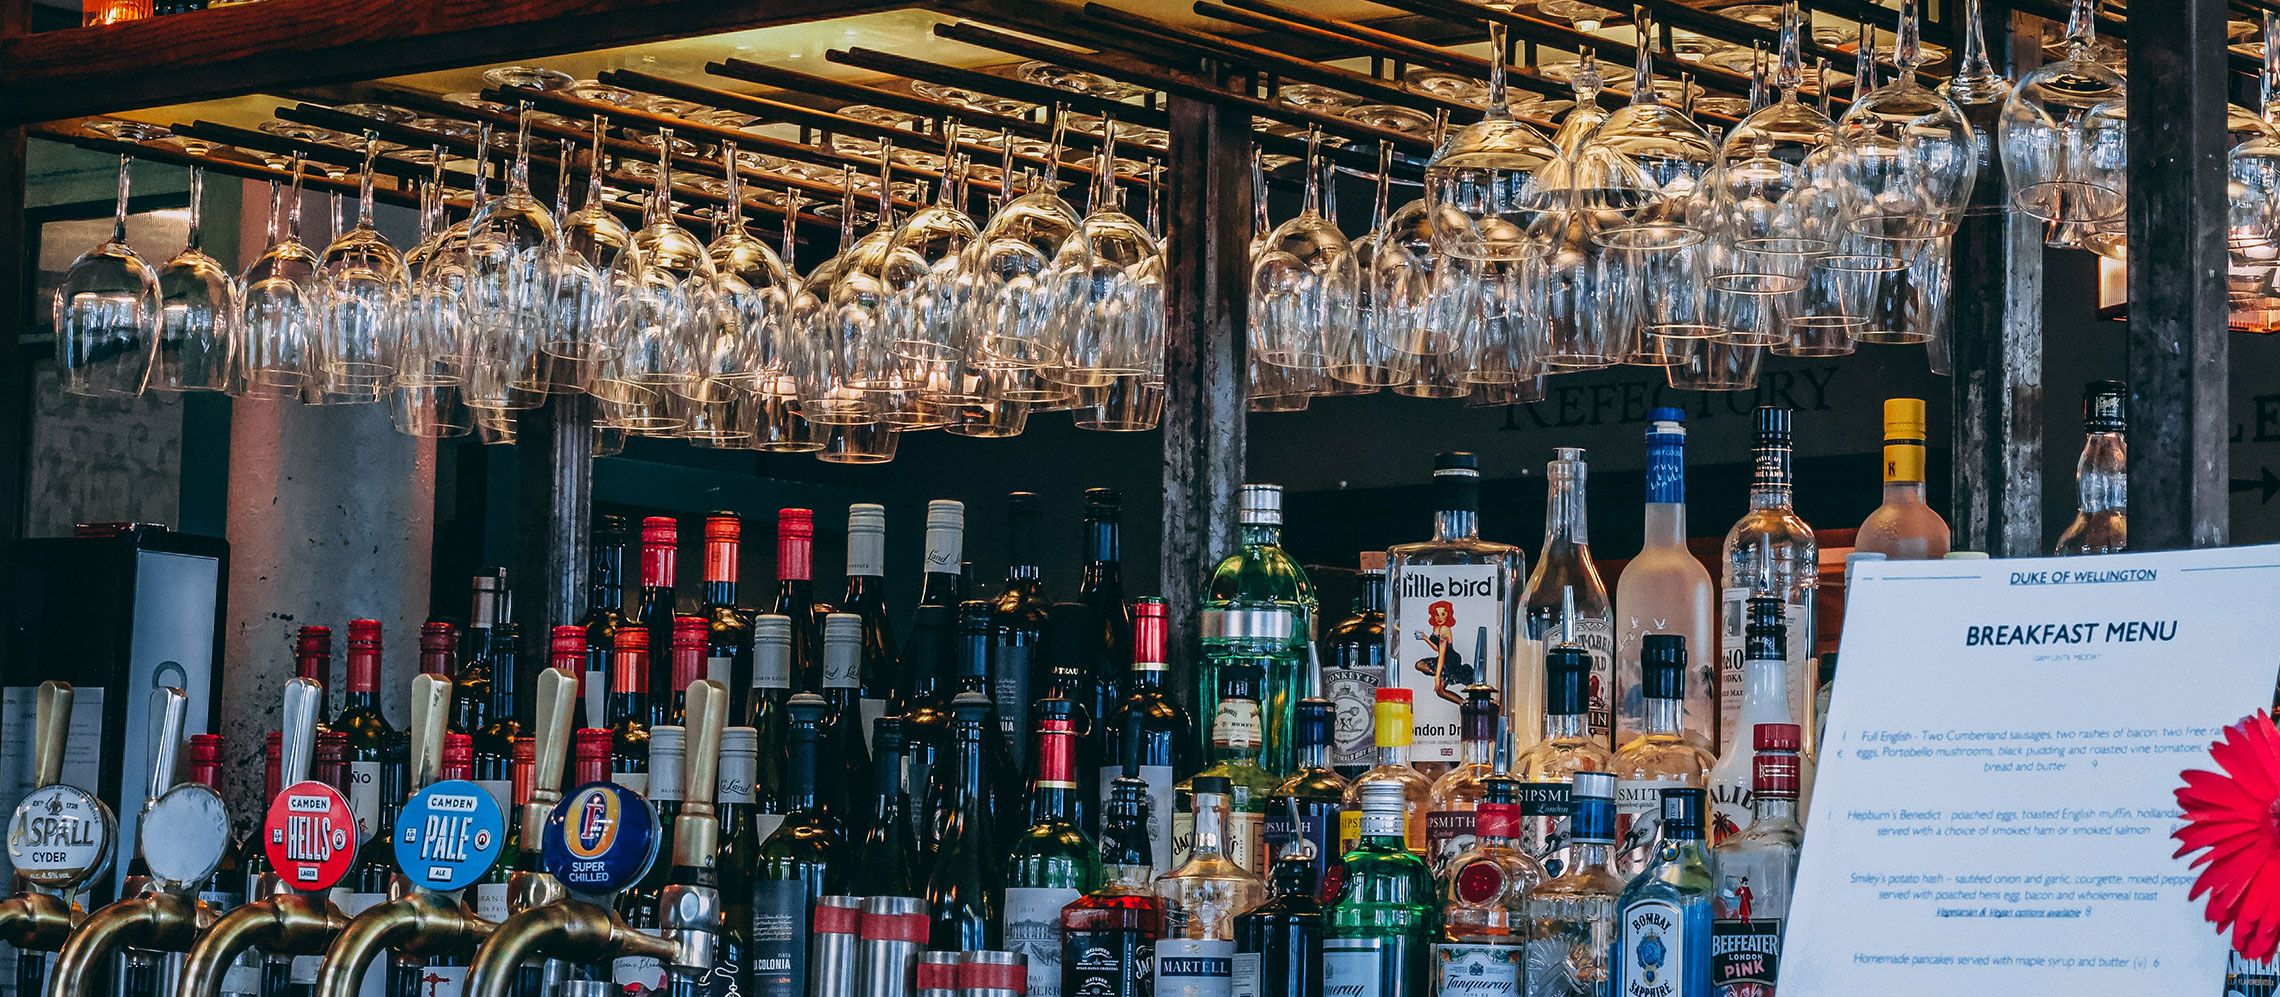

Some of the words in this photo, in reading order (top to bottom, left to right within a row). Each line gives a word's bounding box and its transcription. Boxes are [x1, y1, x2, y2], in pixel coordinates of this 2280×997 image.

[2010, 572, 2047, 584] DUKE
[2051, 571, 2071, 583] OF
[2074, 569, 2157, 582] WELLINGTON
[1449, 576, 1492, 597] bird
[1966, 623, 2099, 646] BREAKFAST
[2105, 620, 2177, 642] MENU
[1364, 676, 1377, 685] 47
[1592, 712, 1607, 725] IN
[1861, 731, 1878, 741] Full
[1881, 731, 1911, 744] English
[1922, 731, 1943, 741] Two
[1947, 730, 2007, 741] Cumberland
[2056, 731, 2076, 739] two
[2079, 730, 2109, 739] rashes
[2113, 728, 2124, 738] of
[2163, 728, 2182, 737] two
[2186, 727, 2206, 737] free
[1883, 747, 1933, 757] Portobello
[1999, 746, 2022, 756] black
[2025, 746, 2065, 757] pudding
[2068, 745, 2086, 754] and
[2090, 745, 2127, 754] roasted
[2130, 745, 2149, 754] vine
[1984, 762, 2012, 772] bread
[2016, 762, 2033, 771] and
[2036, 761, 2067, 771] butter
[2091, 759, 2098, 769] 9
[727, 780, 750, 795] Land
[1519, 790, 1569, 801] SIPSMI
[291, 799, 327, 809] CAMDEN
[431, 798, 473, 809] CAMDEN
[1847, 810, 1896, 823] Hepburn's
[1900, 809, 1942, 820] Benedict
[1951, 809, 1993, 822] poached
[2022, 810, 2058, 819] toasted
[2062, 808, 2096, 821] English
[2137, 808, 2179, 819] hollanda
[10, 811, 94, 853] ASPALL
[287, 815, 331, 861] HELLS
[421, 814, 473, 861] PALE
[1877, 826, 1910, 836] served
[1913, 825, 1933, 835] with
[1936, 828, 1941, 836] a
[1944, 825, 1976, 836] choice
[1979, 825, 1990, 835] of
[1992, 826, 2030, 836] smoked
[2034, 825, 2055, 835] ham
[2058, 827, 2069, 835] or
[2073, 825, 2112, 835] smoked
[2115, 826, 2151, 835] salmon
[1174, 831, 1192, 855] JAC
[32, 852, 67, 863] CYDER
[572, 862, 605, 872] SUPER
[569, 873, 609, 882] CHILLED
[1850, 873, 1886, 887] Smiley's
[1888, 874, 1920, 885] potato
[1922, 873, 1944, 884] hash
[1994, 875, 2022, 884] onion
[2024, 874, 2042, 884] and
[2127, 874, 2159, 884] mixed
[1879, 890, 1910, 900] served
[1912, 889, 1932, 899] with
[1935, 889, 1976, 901] poached
[1979, 890, 2000, 899] hens
[2025, 891, 2053, 900] bacon
[2057, 891, 2075, 900] and
[2078, 891, 2132, 900] wholemeal
[2134, 891, 2158, 900] toast
[1632, 913, 1672, 935] BOMBAY
[1712, 934, 1778, 957] BEEFEATER
[759, 959, 791, 970] COLONIA
[1135, 956, 1154, 979] JAC
[1163, 961, 1228, 973] MARTELL
[1853, 953, 1909, 965] Homemade
[1912, 954, 1954, 966] pancakes
[1957, 954, 1989, 966] served
[1992, 955, 2014, 966] with
[2016, 956, 2045, 967] maple
[2048, 957, 2073, 969] syrup
[2077, 956, 2095, 967] and
[2099, 956, 2129, 967] butter
[2153, 957, 2160, 968] 6
[1724, 959, 1765, 979] PINK
[1446, 975, 1514, 995] Tanqueray
[1629, 979, 1674, 997] SAPPHIRE
